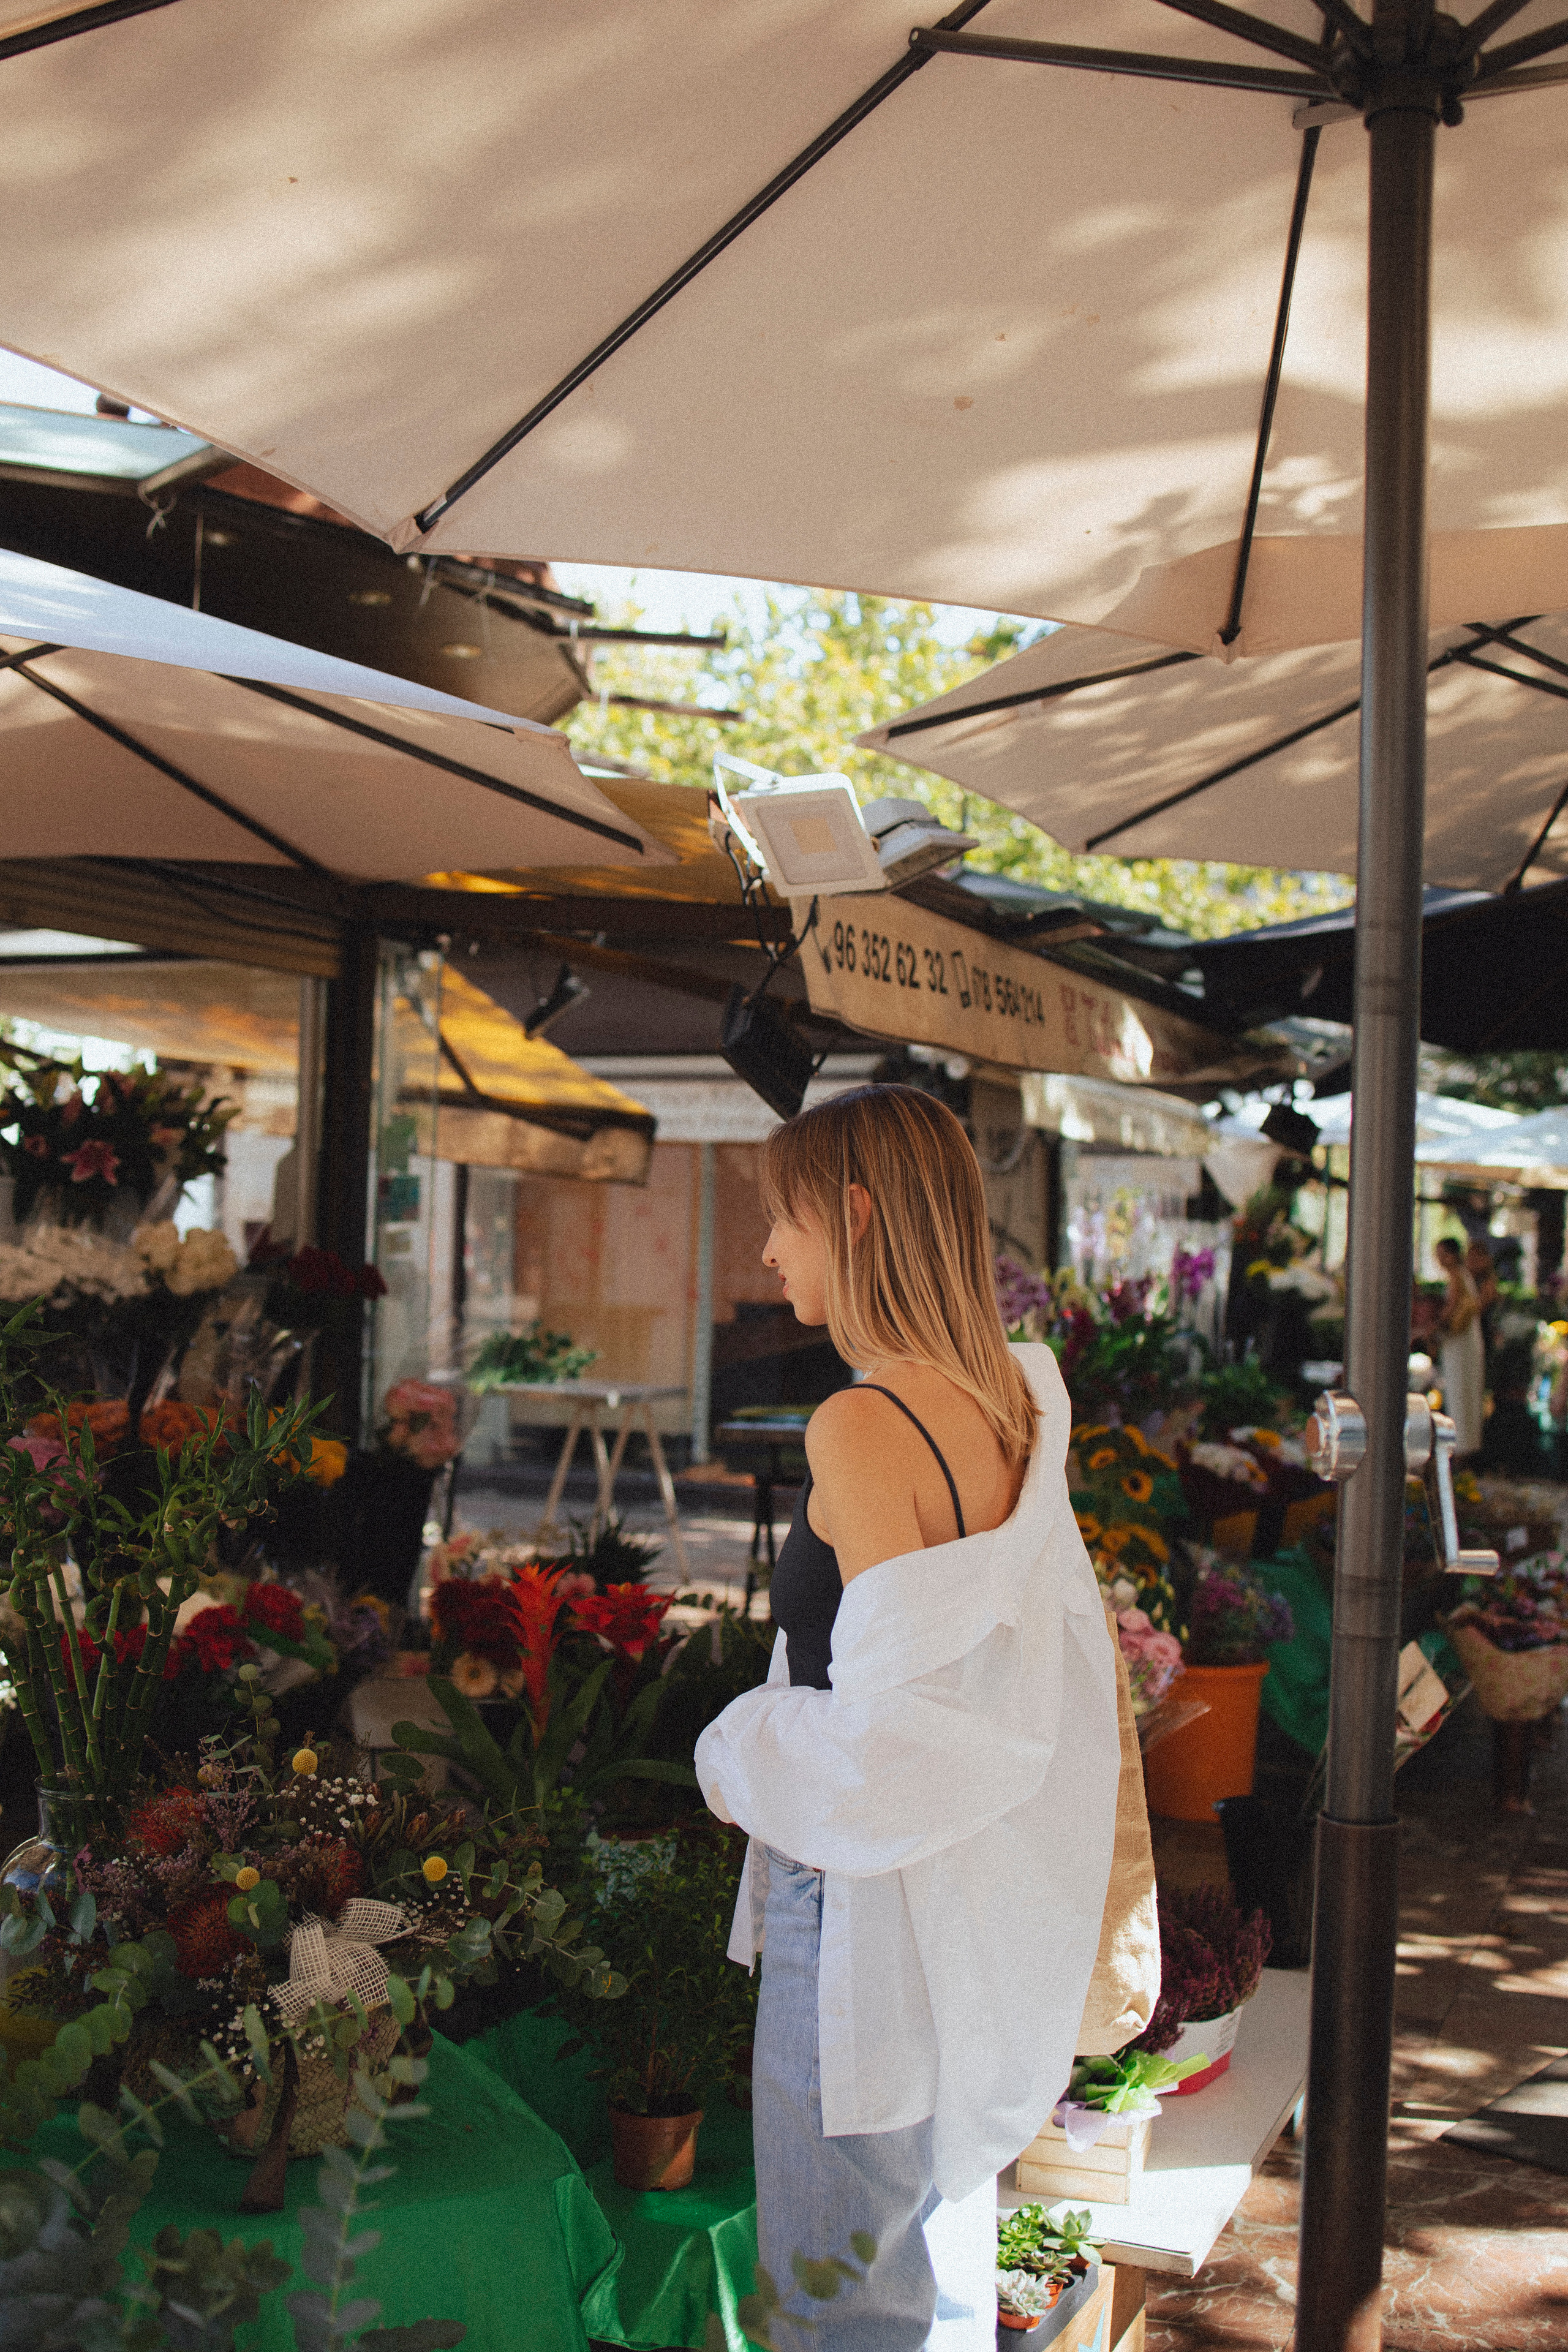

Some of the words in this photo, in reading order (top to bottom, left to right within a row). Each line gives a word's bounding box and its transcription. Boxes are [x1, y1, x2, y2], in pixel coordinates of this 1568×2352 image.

[834, 920, 856, 973] 96
[862, 929, 892, 983] 352
[897, 941, 921, 989] 62
[924, 948, 949, 995] 32
